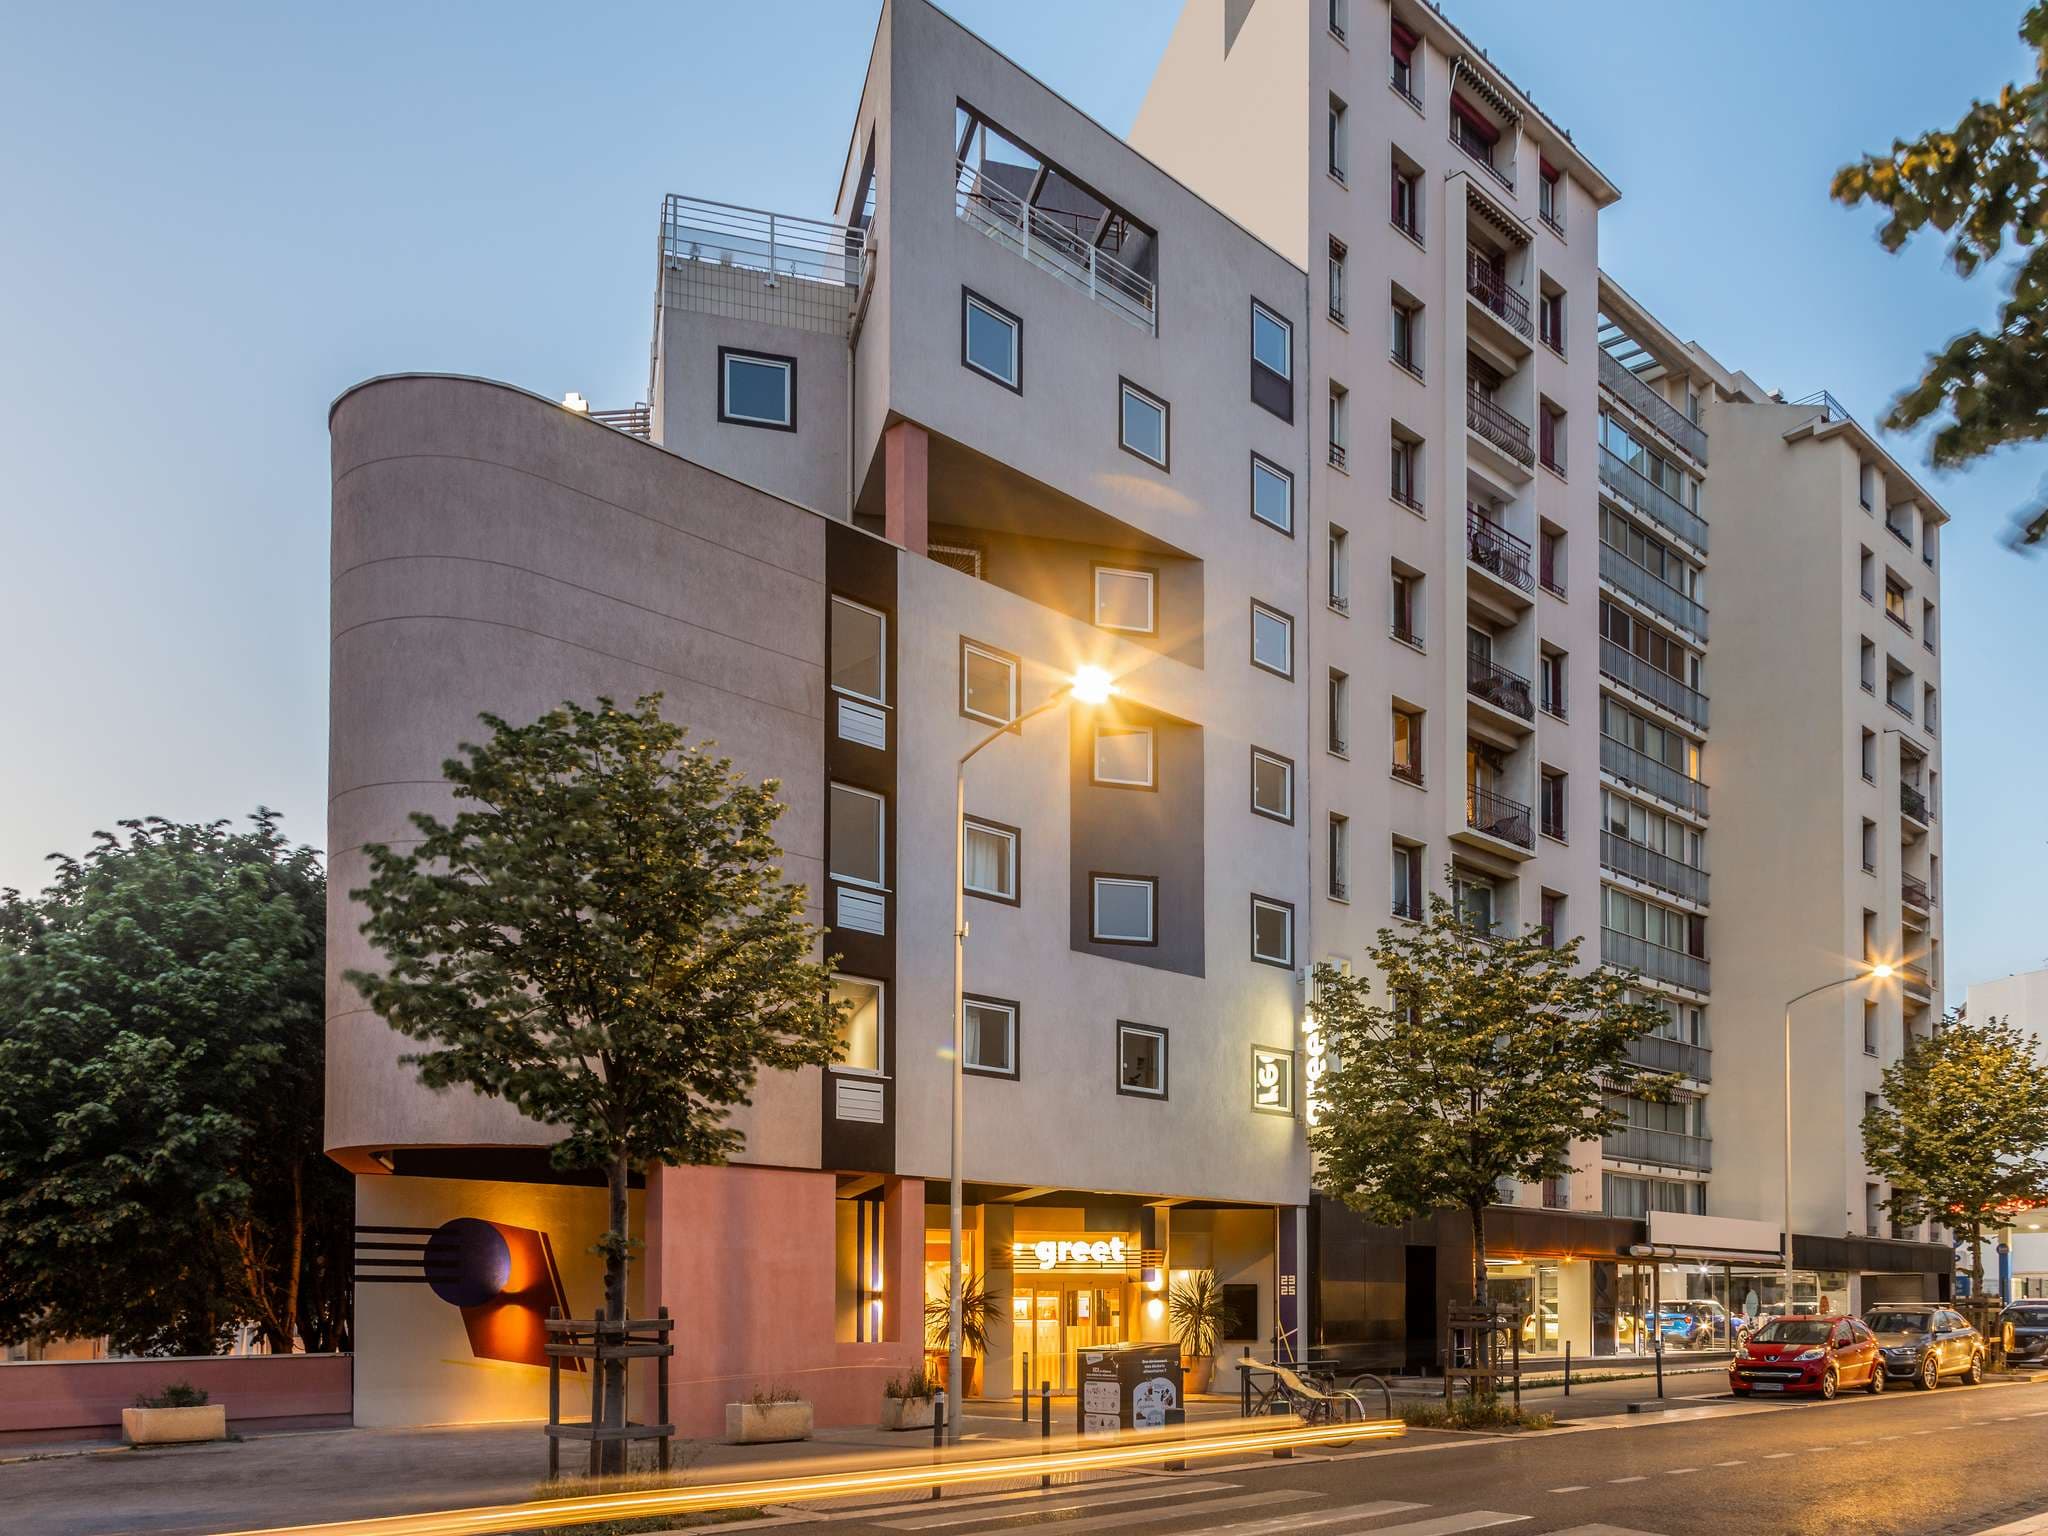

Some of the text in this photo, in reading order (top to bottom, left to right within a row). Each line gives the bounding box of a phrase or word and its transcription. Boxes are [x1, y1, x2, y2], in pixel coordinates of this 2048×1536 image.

[1034, 1236, 1126, 1271] greet
[1280, 1275, 1296, 1285] 23
[1280, 1286, 1296, 1296] 25
